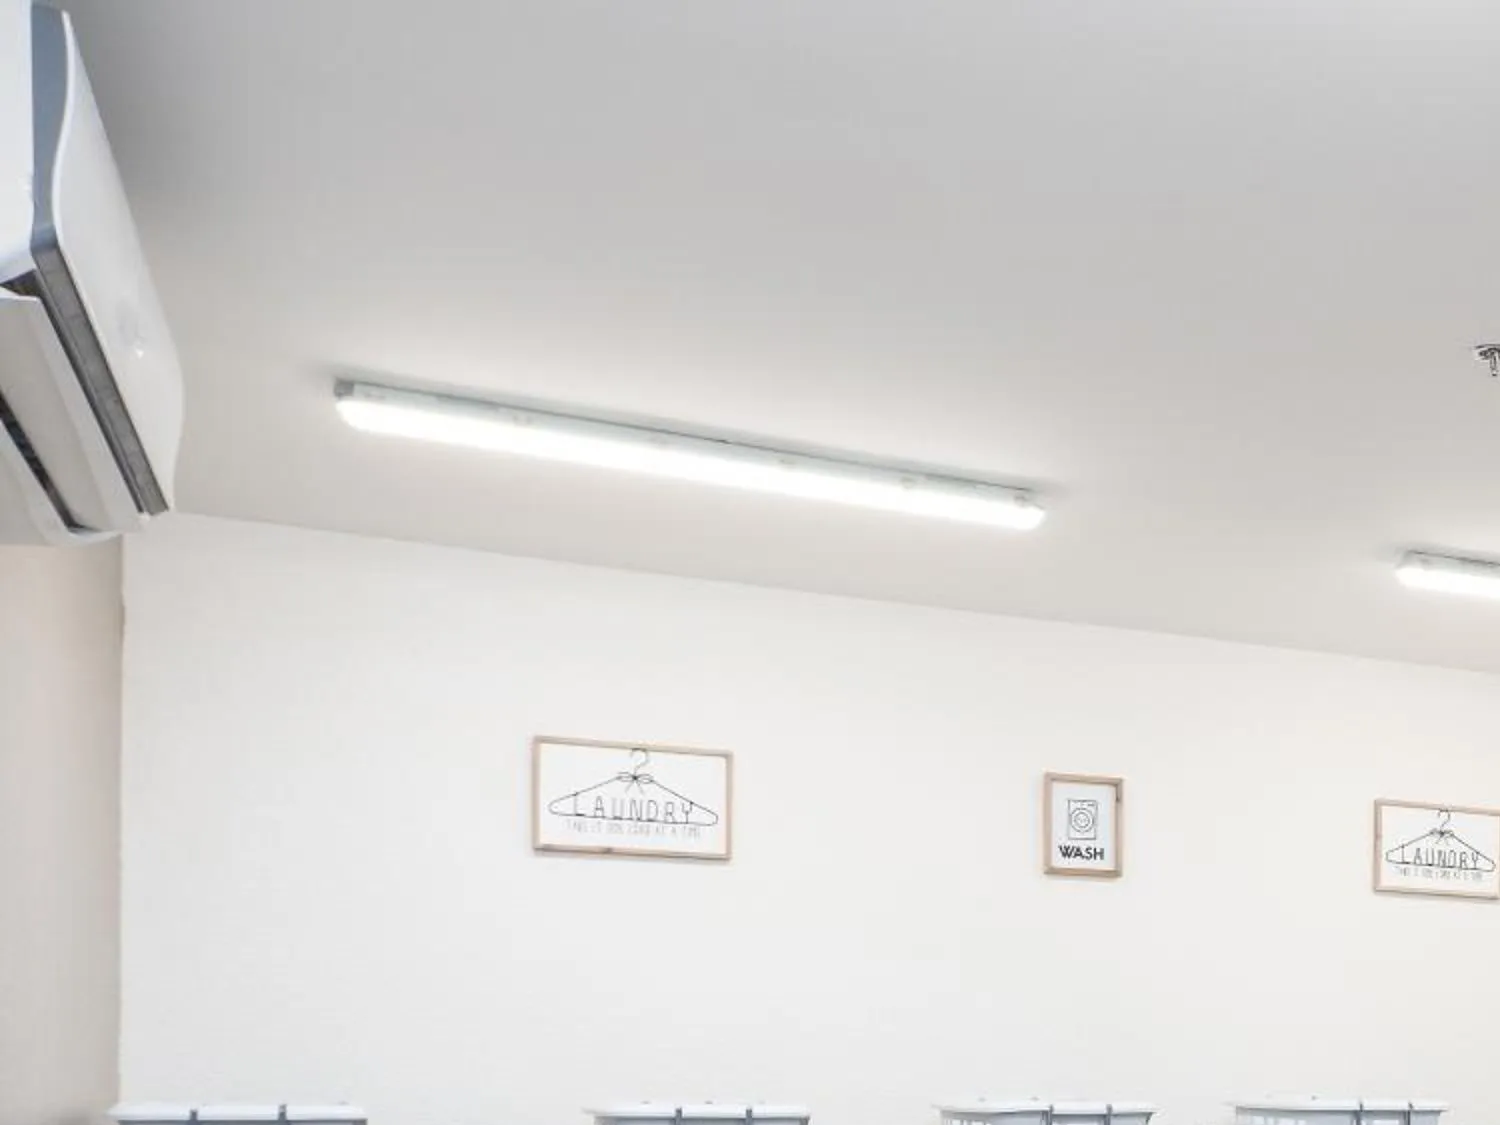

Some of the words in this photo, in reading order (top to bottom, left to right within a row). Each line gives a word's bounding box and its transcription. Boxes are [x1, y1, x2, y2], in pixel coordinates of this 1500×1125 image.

[573, 792, 693, 824] LAUNDRY
[1058, 844, 1104, 860] WASH
[1401, 845, 1479, 870] LAUNDRY
